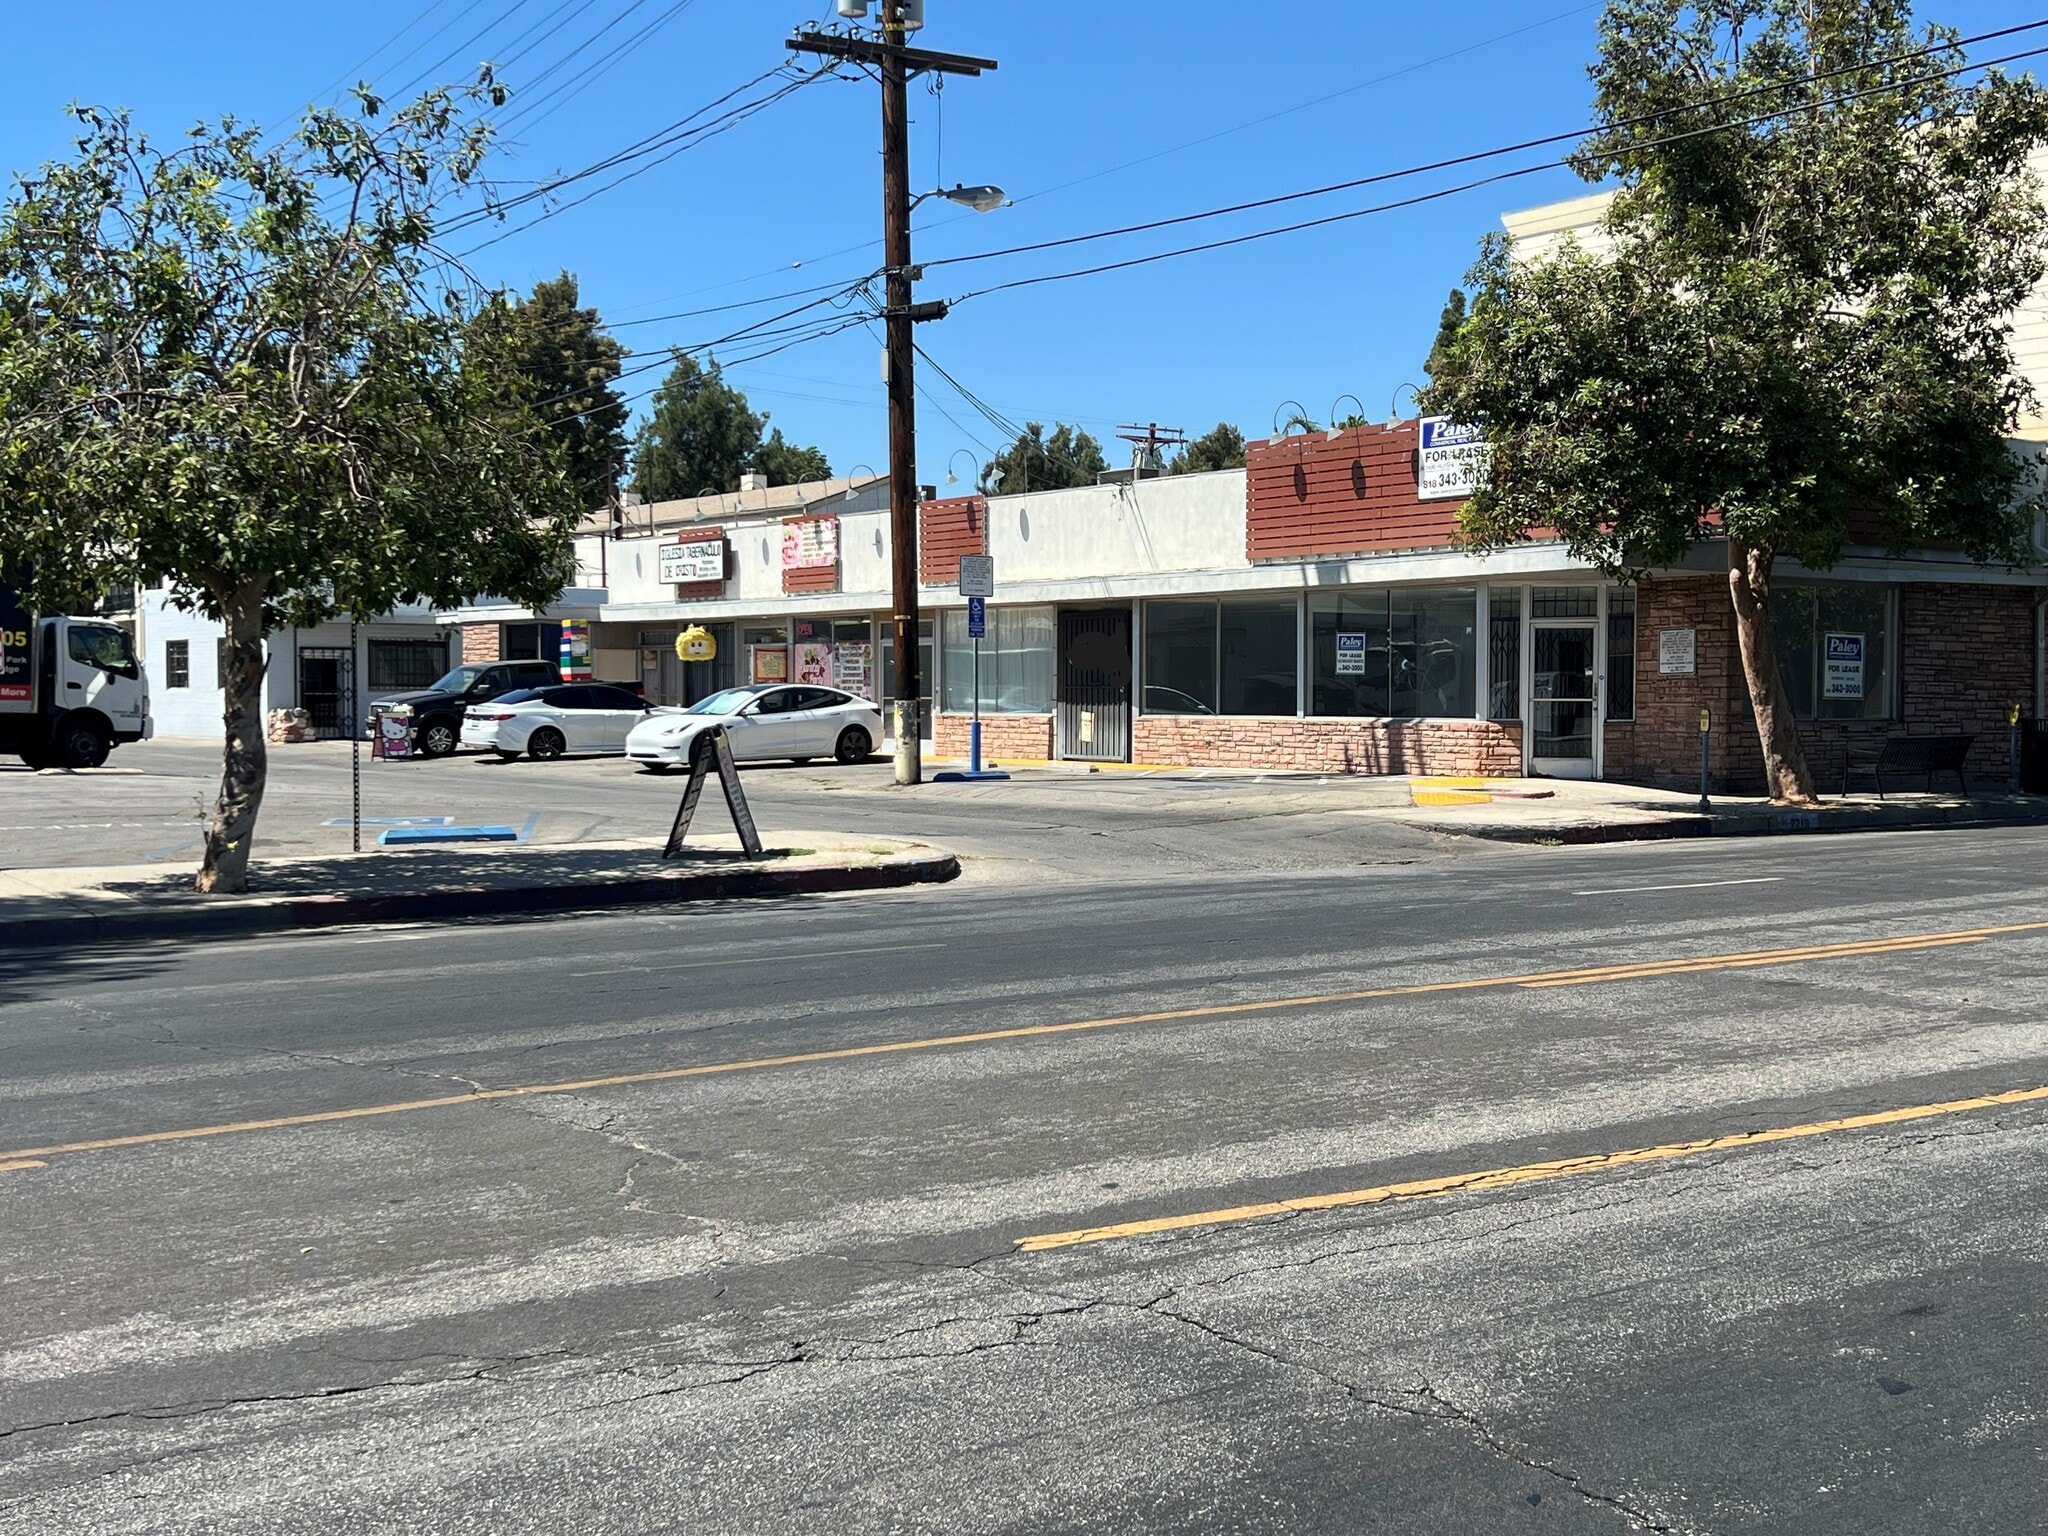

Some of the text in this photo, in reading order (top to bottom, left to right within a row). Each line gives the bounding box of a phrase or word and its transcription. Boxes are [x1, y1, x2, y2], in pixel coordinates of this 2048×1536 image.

[1425, 450, 1448, 463] FOR
[1422, 468, 1489, 489] 818 343-300
[661, 546, 685, 561] IGLESIA
[664, 564, 697, 578] DE CRISTO
[1340, 636, 1363, 647] Paley
[1829, 638, 1860, 654] Paley
[6, 656, 28, 664] Park
[1842, 665, 1860, 673] LEASE
[1, 688, 27, 696] More
